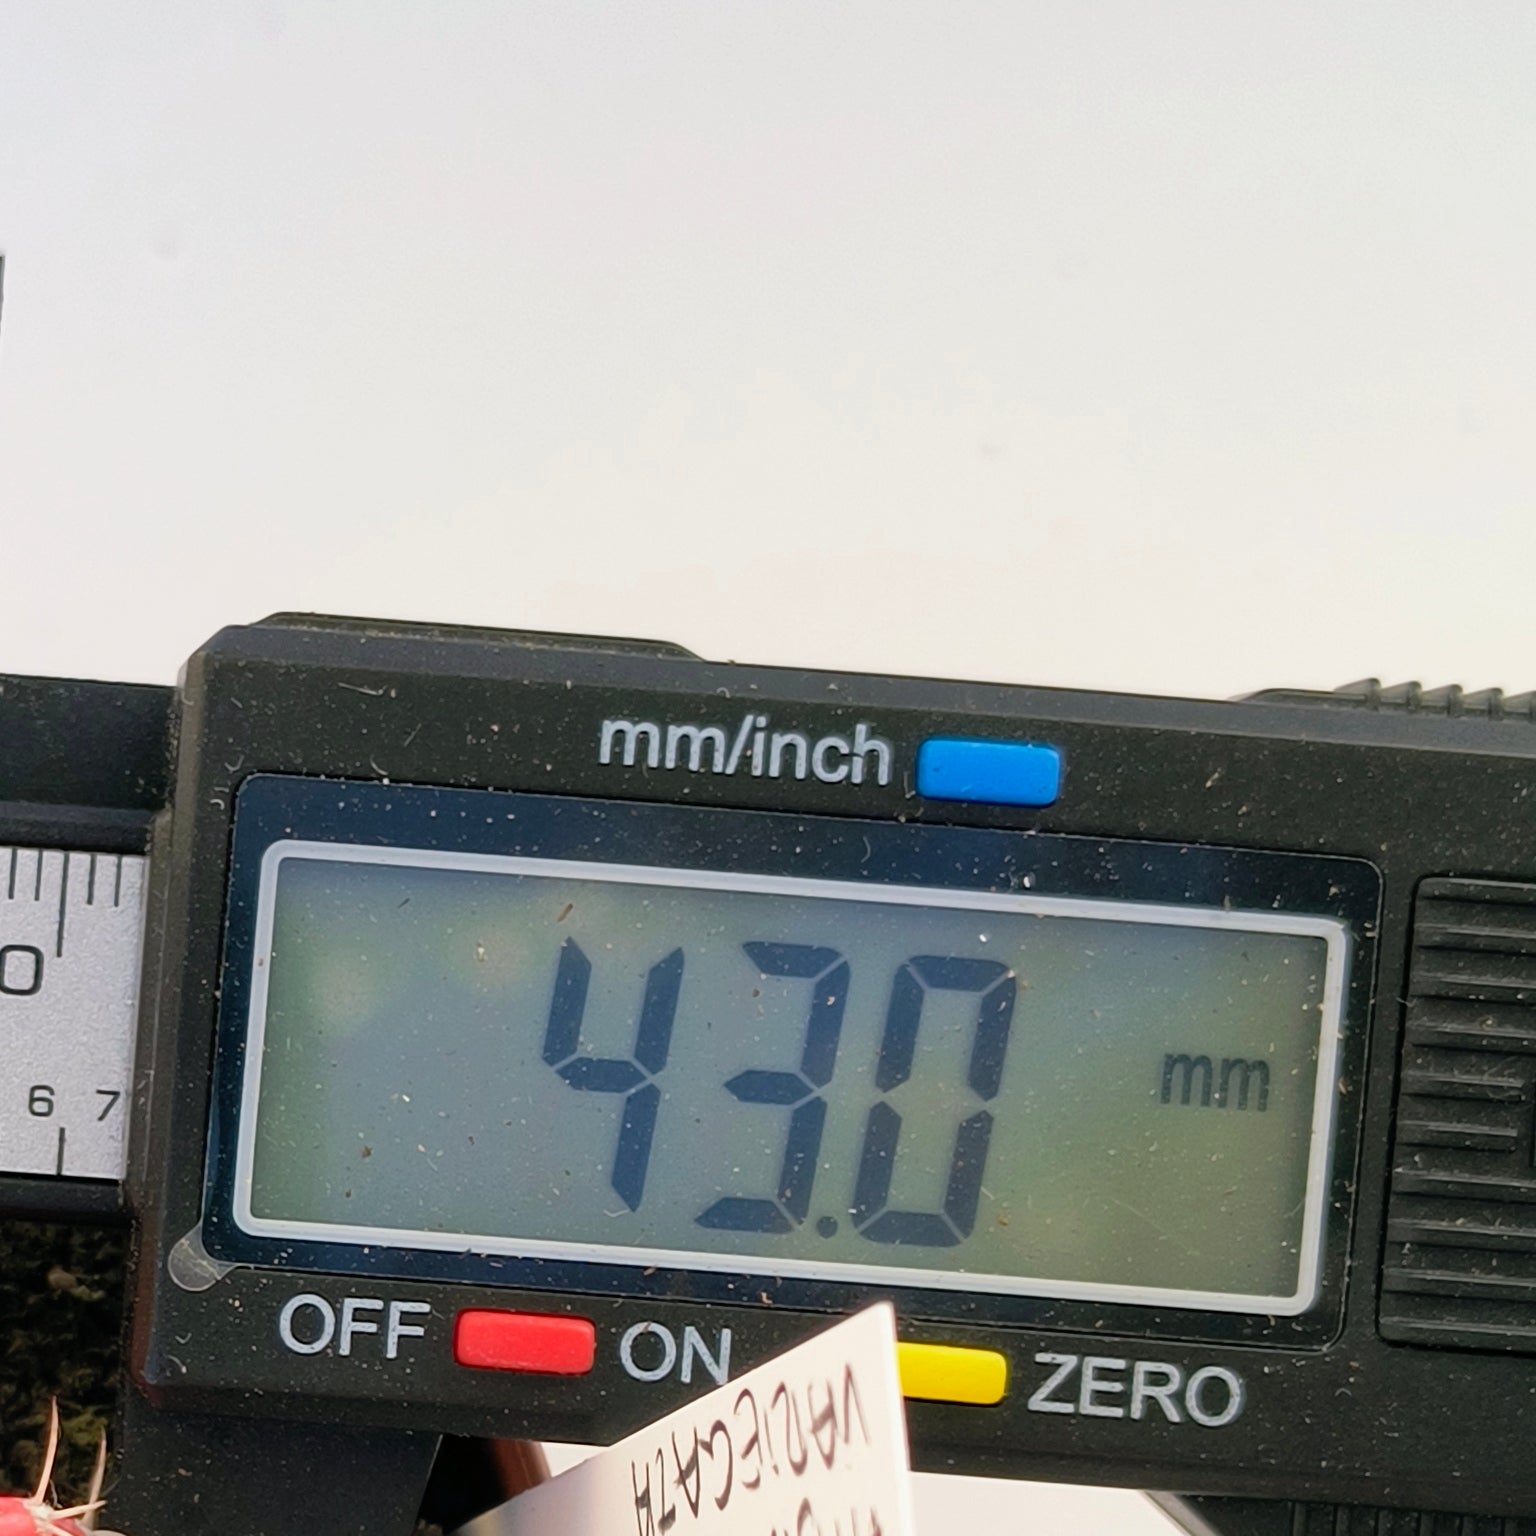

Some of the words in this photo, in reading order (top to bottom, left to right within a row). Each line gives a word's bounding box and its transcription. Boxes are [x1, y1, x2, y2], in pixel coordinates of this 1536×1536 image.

[598, 713, 891, 786] mm/inch
[27, 1084, 56, 1118] 6
[94, 1088, 122, 1122] 7
[542, 936, 1018, 1249] 43.0
[1159, 1048, 1271, 1113] mm
[278, 1293, 432, 1360] OFF
[619, 1320, 732, 1386] ON
[1027, 1351, 1244, 1427] ZERO
